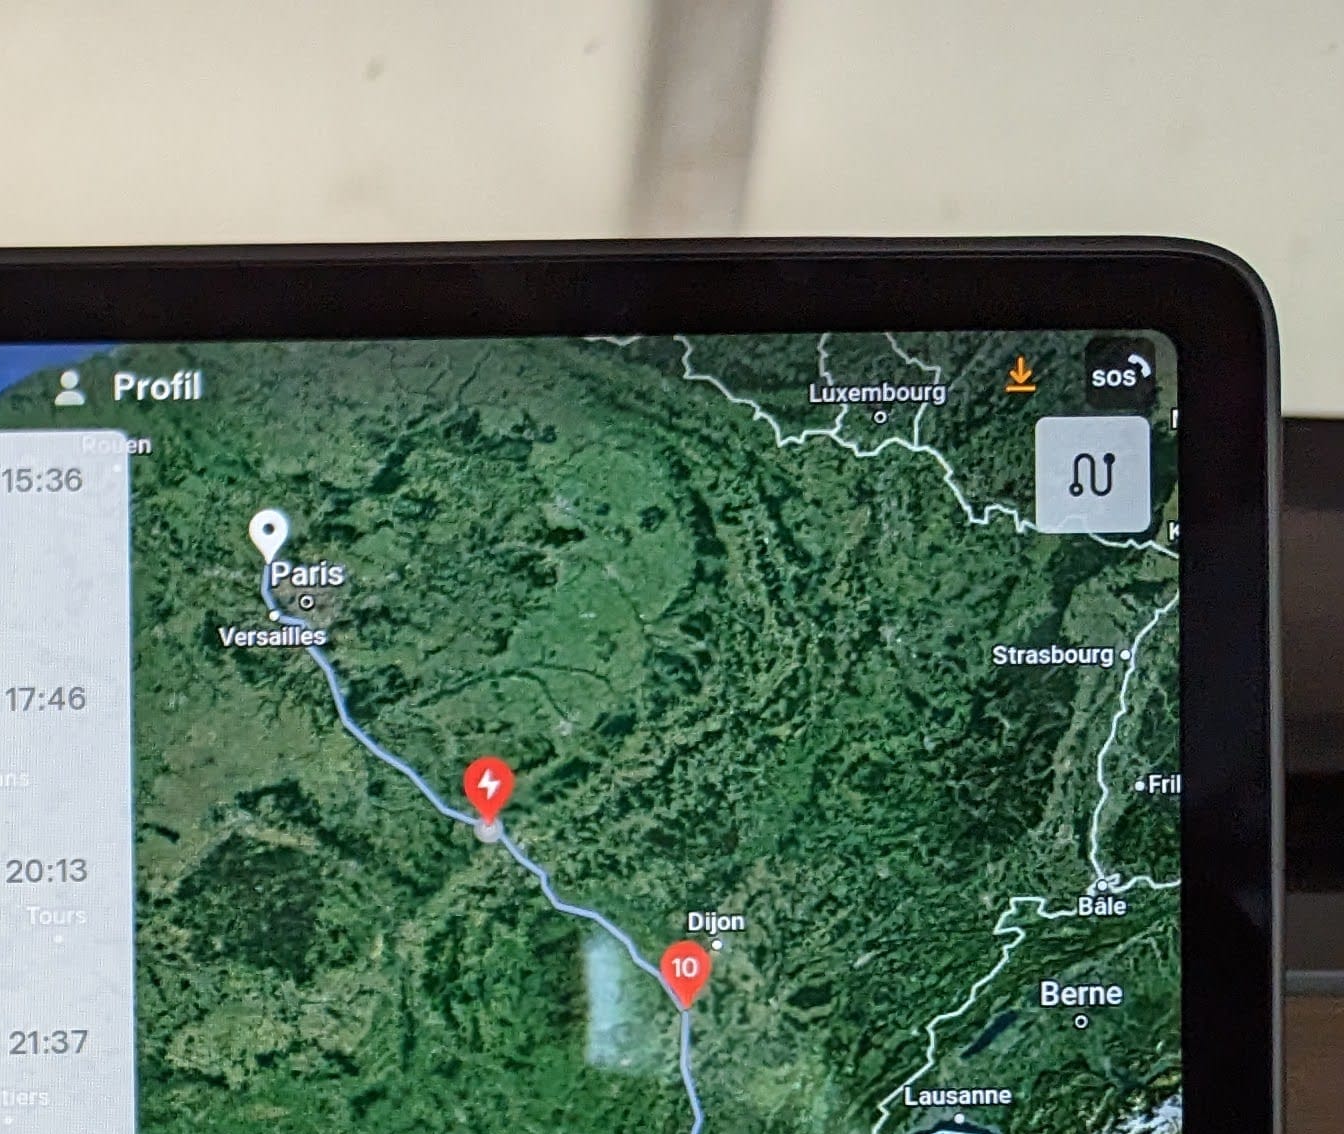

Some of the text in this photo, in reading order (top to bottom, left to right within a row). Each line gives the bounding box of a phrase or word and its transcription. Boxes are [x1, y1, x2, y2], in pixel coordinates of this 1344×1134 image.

[113, 370, 203, 402] Profil
[808, 383, 947, 406] Luxembourg
[82, 435, 152, 455] Rouen
[0, 467, 83, 495] 15:36
[270, 562, 345, 587] Paris
[219, 627, 327, 648] Versailles
[992, 645, 1115, 668] Strasbourg
[4, 685, 86, 712] 17:46
[4, 858, 88, 886] 20:13
[26, 905, 87, 925] Tours
[1077, 895, 1127, 916] Bâle
[687, 911, 745, 934] Dijon
[671, 957, 698, 977] 10
[1040, 981, 1123, 1005] Berne
[8, 1028, 89, 1056] 21:37
[903, 1086, 1013, 1106] Lausanne
